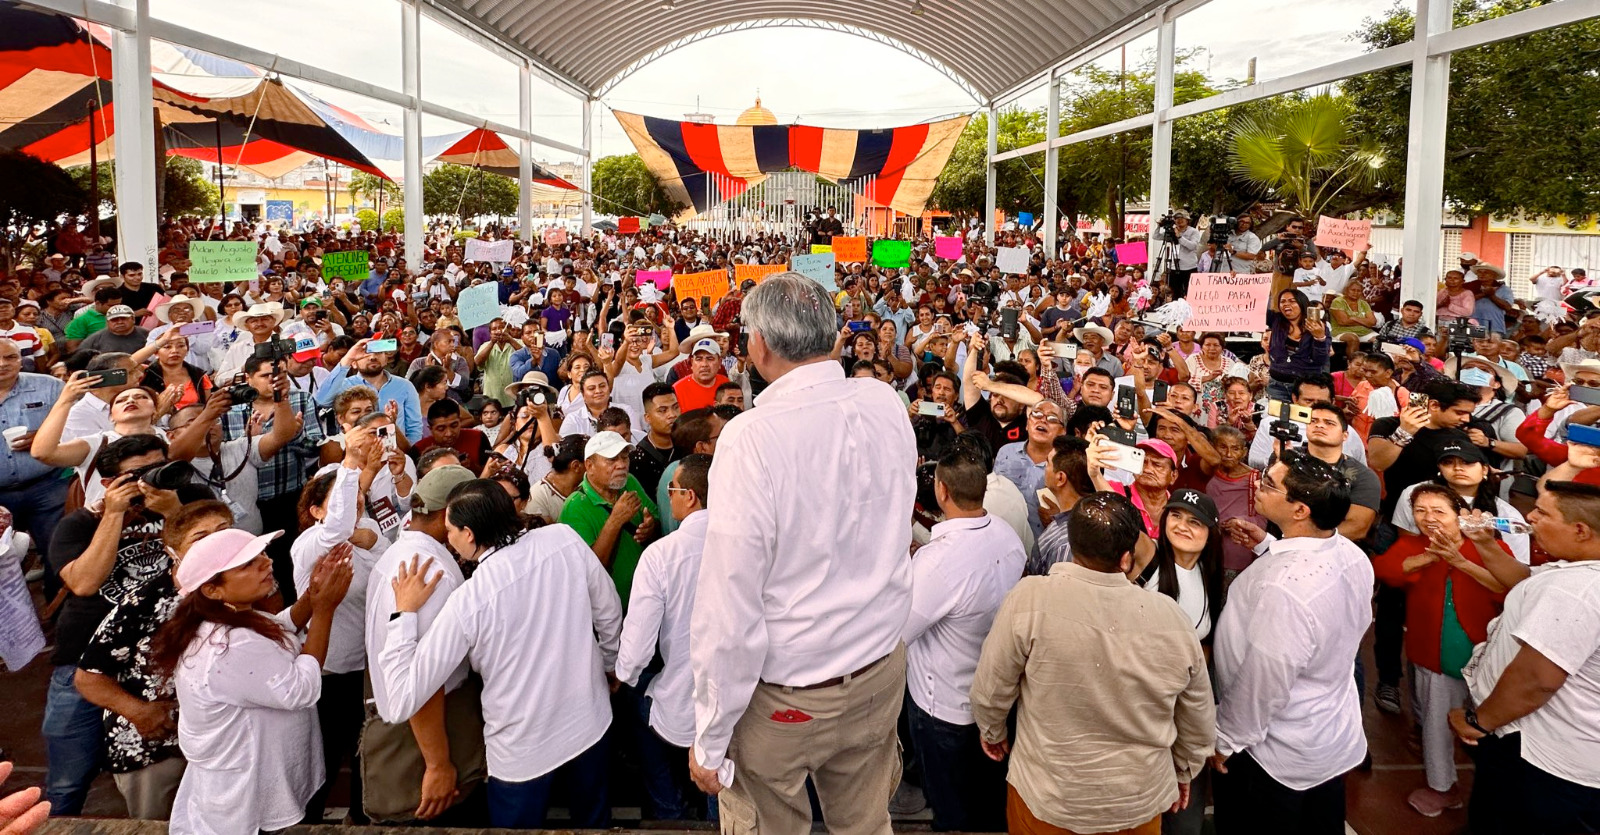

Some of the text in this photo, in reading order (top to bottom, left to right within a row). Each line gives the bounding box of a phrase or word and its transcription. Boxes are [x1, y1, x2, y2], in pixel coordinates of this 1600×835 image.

[219, 244, 253, 256] Augusto
[1190, 276, 1201, 286] LA
[1194, 290, 1252, 301] LLEGO PARA
[1215, 317, 1250, 327] AUGUSTO
[380, 515, 398, 530] TAFF
